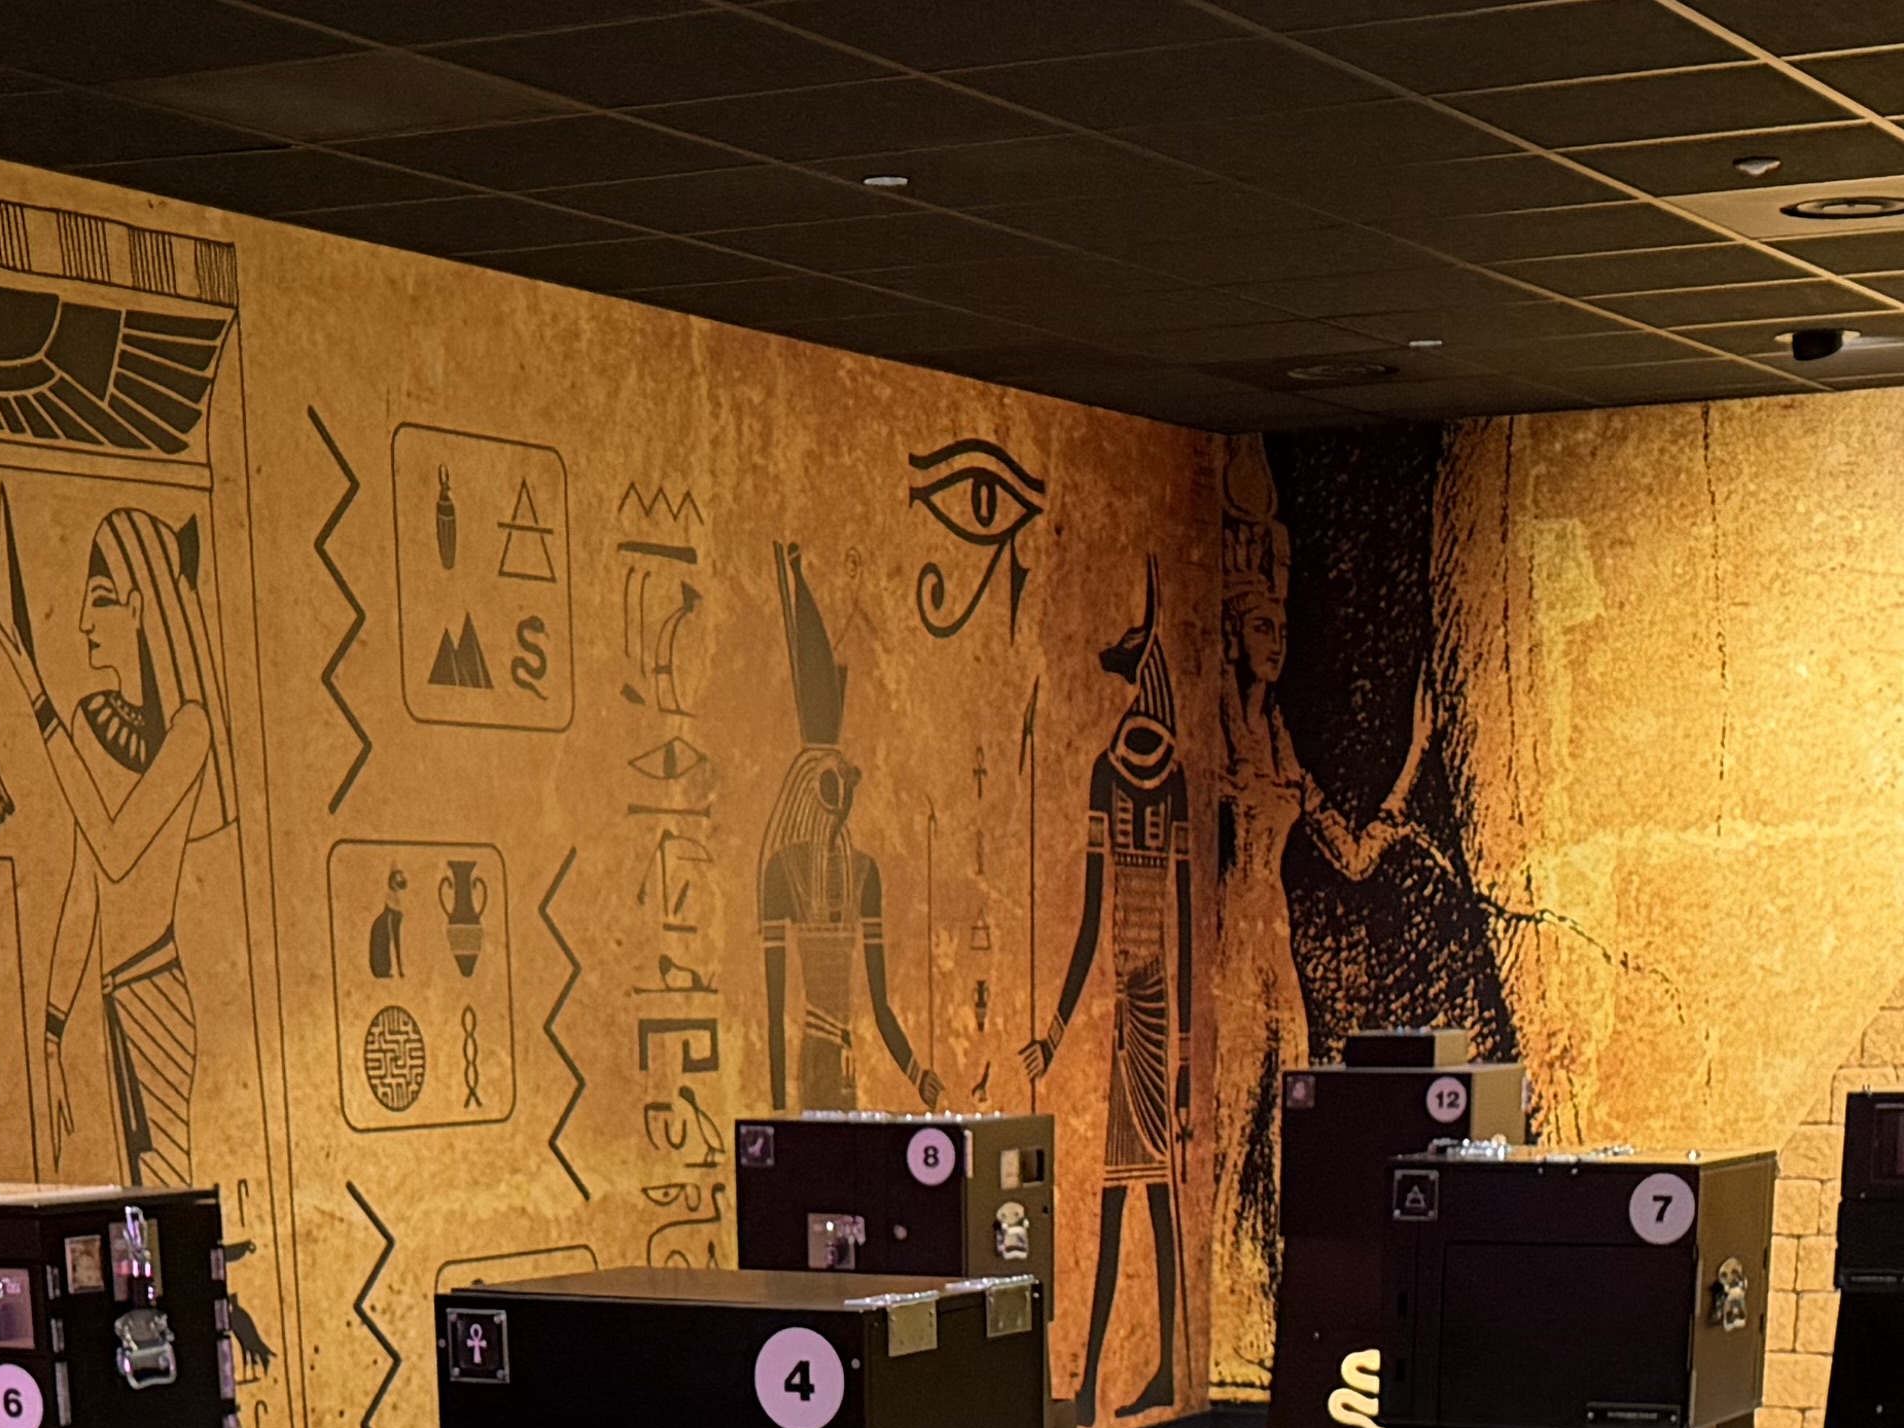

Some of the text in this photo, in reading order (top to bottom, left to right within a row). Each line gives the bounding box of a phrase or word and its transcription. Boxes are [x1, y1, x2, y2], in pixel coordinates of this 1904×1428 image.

[1435, 1090, 1461, 1109] 12
[923, 1145, 940, 1168] 8
[1652, 1195, 1673, 1223] 7
[784, 1360, 815, 1402] 4
[3, 1388, 23, 1418] 6
